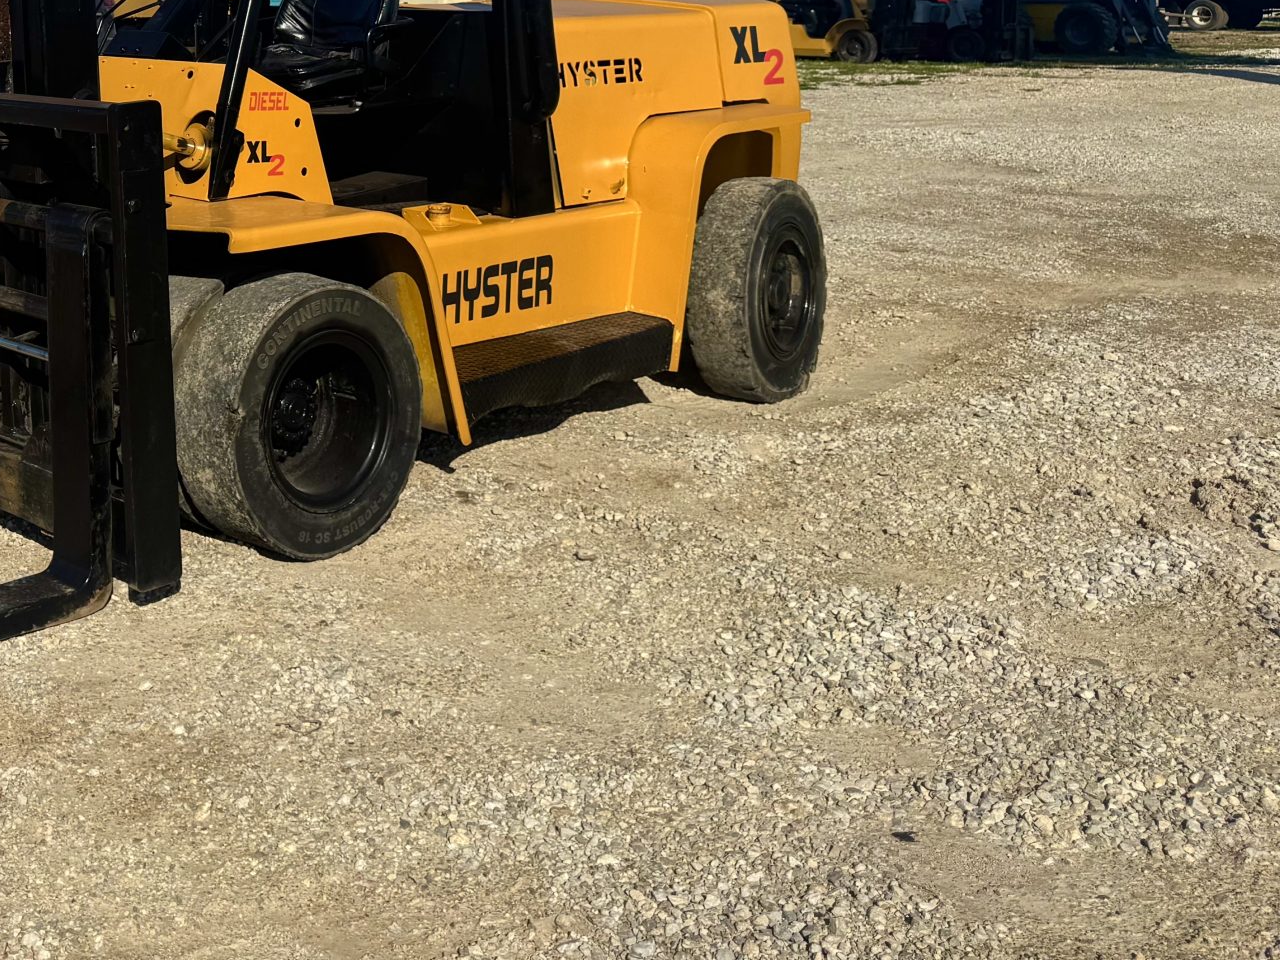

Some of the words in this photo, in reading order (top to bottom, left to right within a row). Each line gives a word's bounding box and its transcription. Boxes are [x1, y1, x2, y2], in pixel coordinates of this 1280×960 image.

[558, 57, 644, 88] HYSTER
[249, 92, 289, 111] DIESEL
[442, 255, 553, 324] HYSTER
[257, 297, 363, 371] CONTINENTAL
